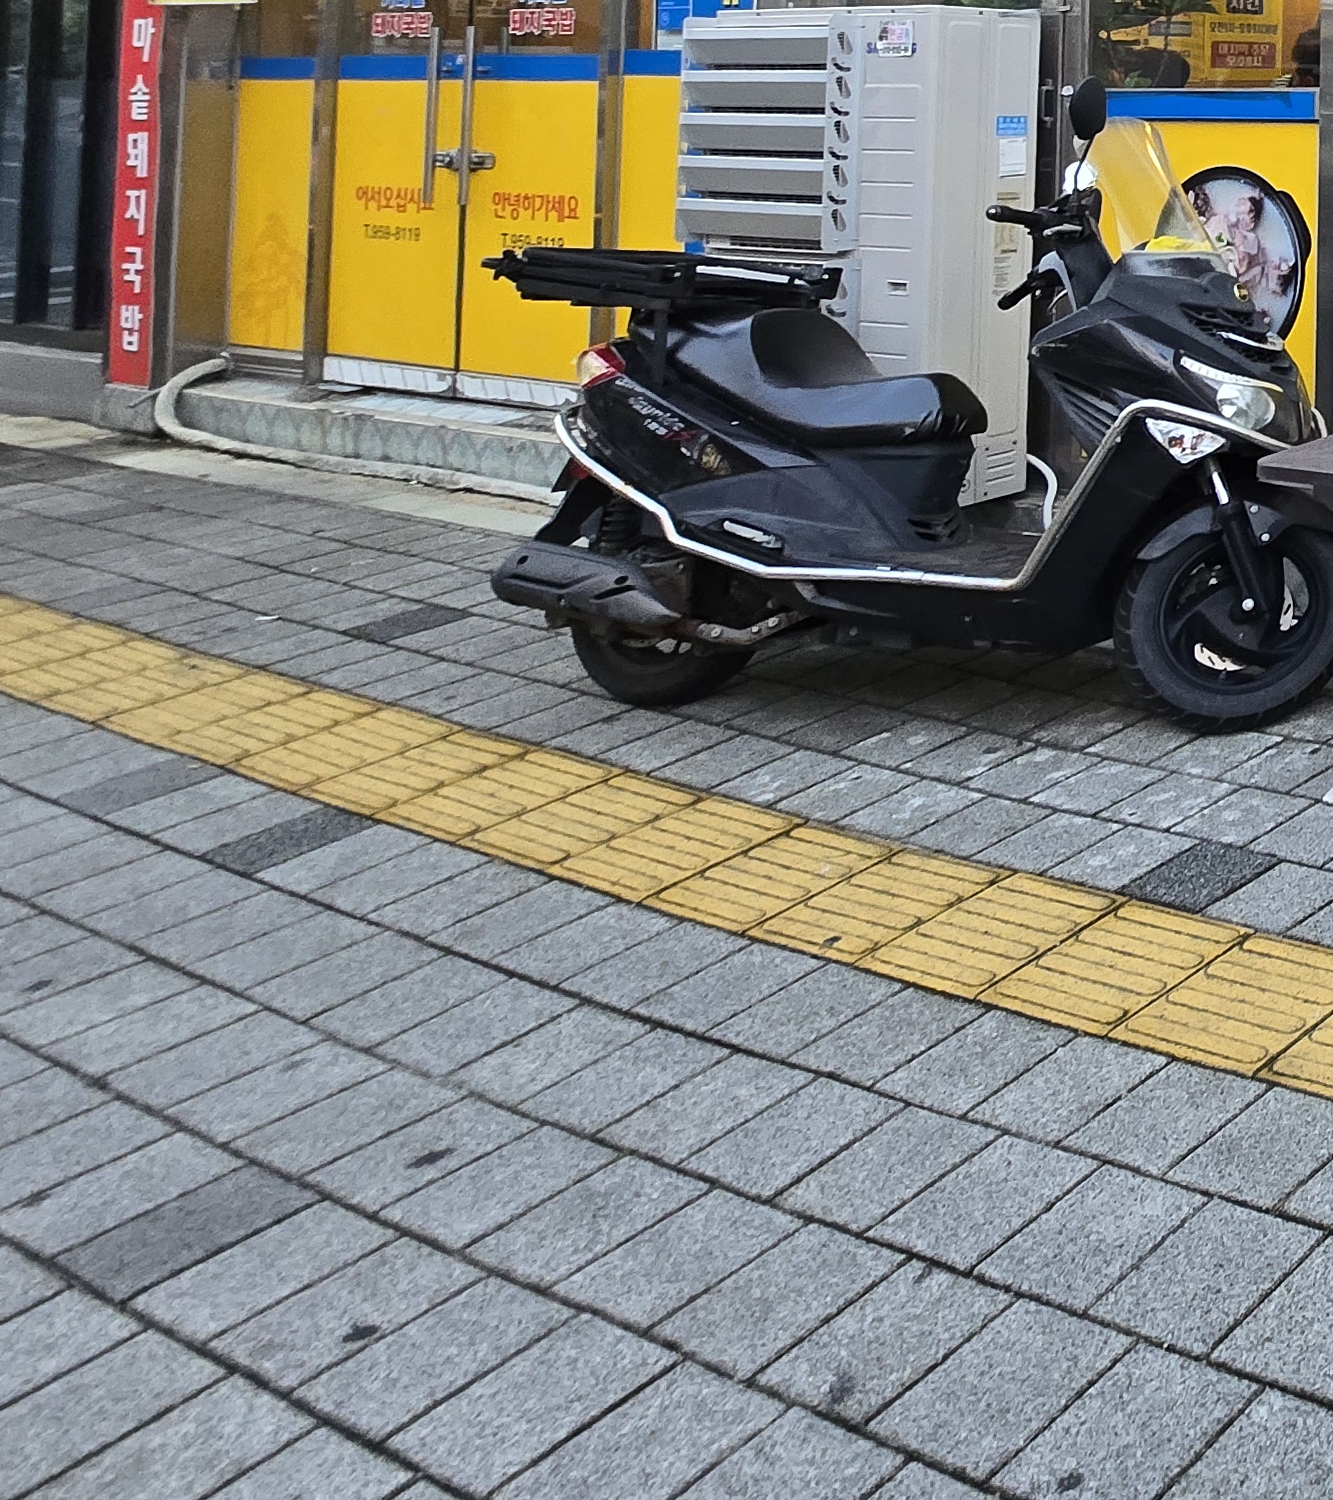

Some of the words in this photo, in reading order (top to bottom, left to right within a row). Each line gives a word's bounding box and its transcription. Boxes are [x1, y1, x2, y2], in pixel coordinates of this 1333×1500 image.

[371, 11, 433, 37] 돼지국밥
[509, 8, 575, 35] 돼지국밥
[492, 191, 580, 222] 안녕히가세요
